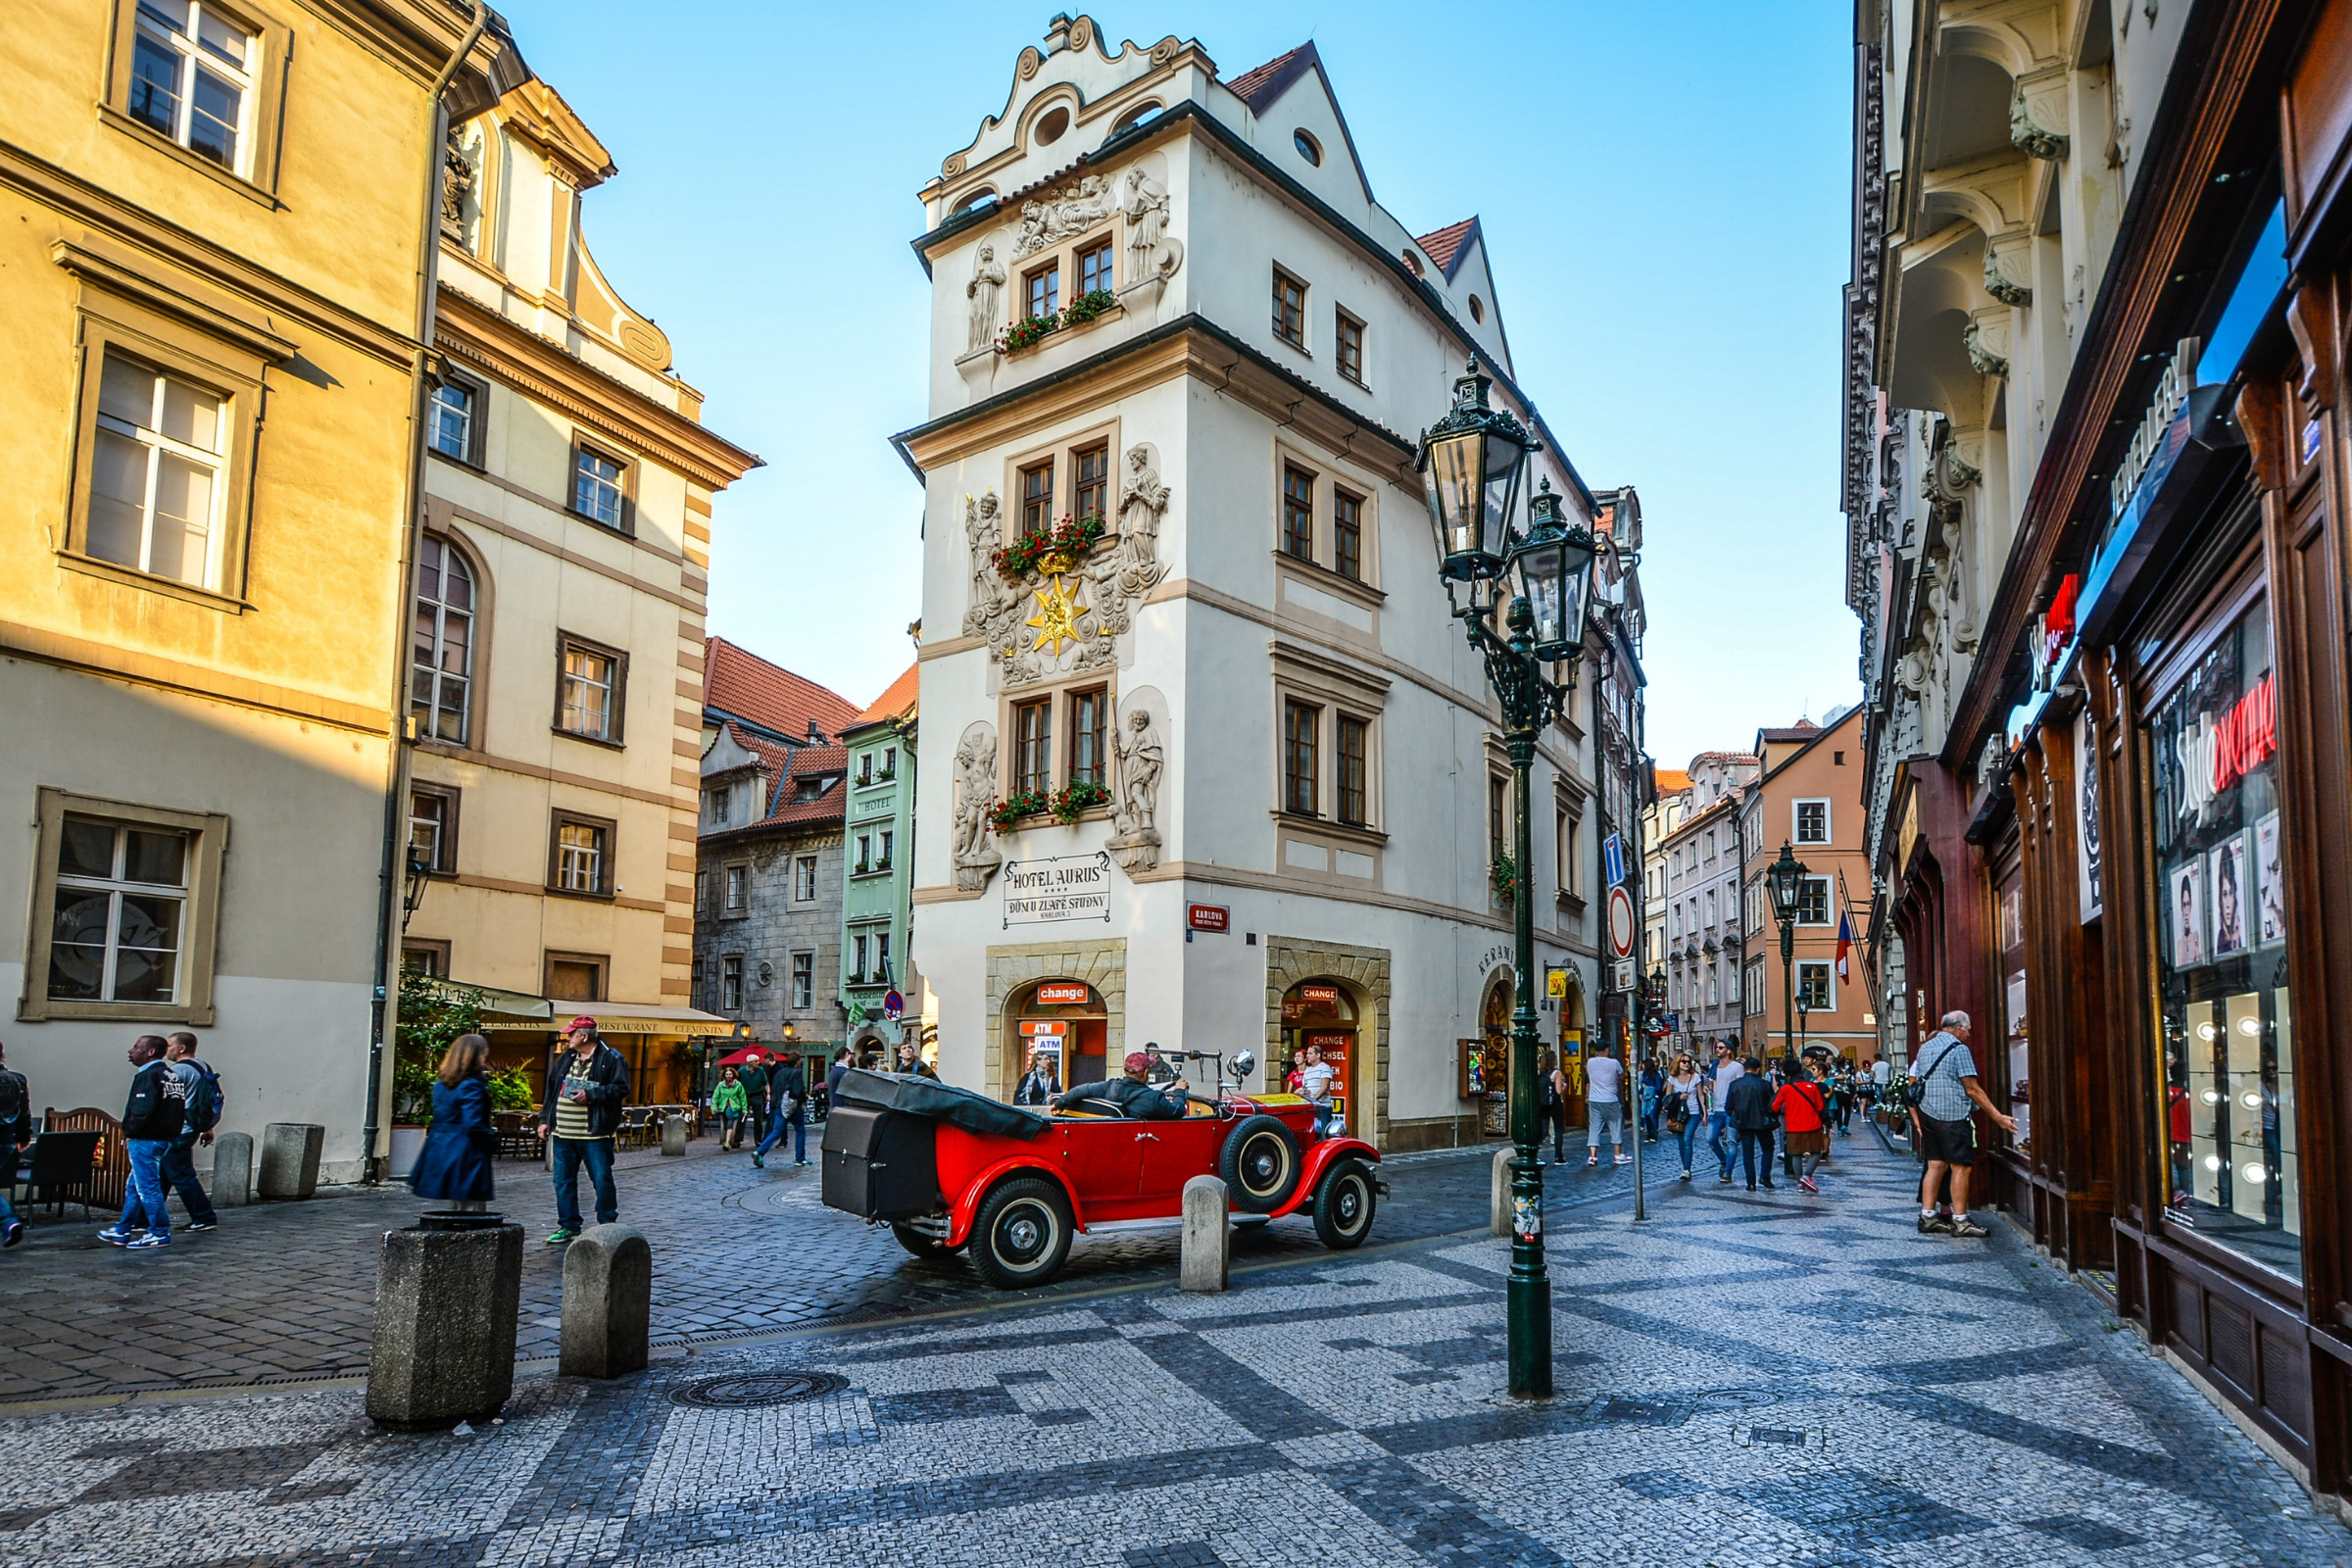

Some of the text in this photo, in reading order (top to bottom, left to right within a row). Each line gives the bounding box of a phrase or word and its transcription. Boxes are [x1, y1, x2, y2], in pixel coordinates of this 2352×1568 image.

[864, 797, 890, 811] HOTEL
[1013, 866, 1100, 889] HOTEL AURUS
[1031, 901, 1037, 912] U
[1068, 896, 1105, 909] STUDNY
[1196, 909, 1223, 920] KARLOVA
[1478, 945, 1516, 976] KERAMI
[1041, 988, 1084, 1000] change
[1303, 989, 1336, 999] CHANGE
[598, 1022, 723, 1034] RESTAURANT CLEMENTIN
[1034, 1023, 1052, 1034] ATM
[1039, 1040, 1060, 1049] ATM
[1313, 1036, 1344, 1045] CHANGE
[1322, 1051, 1347, 1060] CHSEL
[1329, 1081, 1344, 1091] BIO
